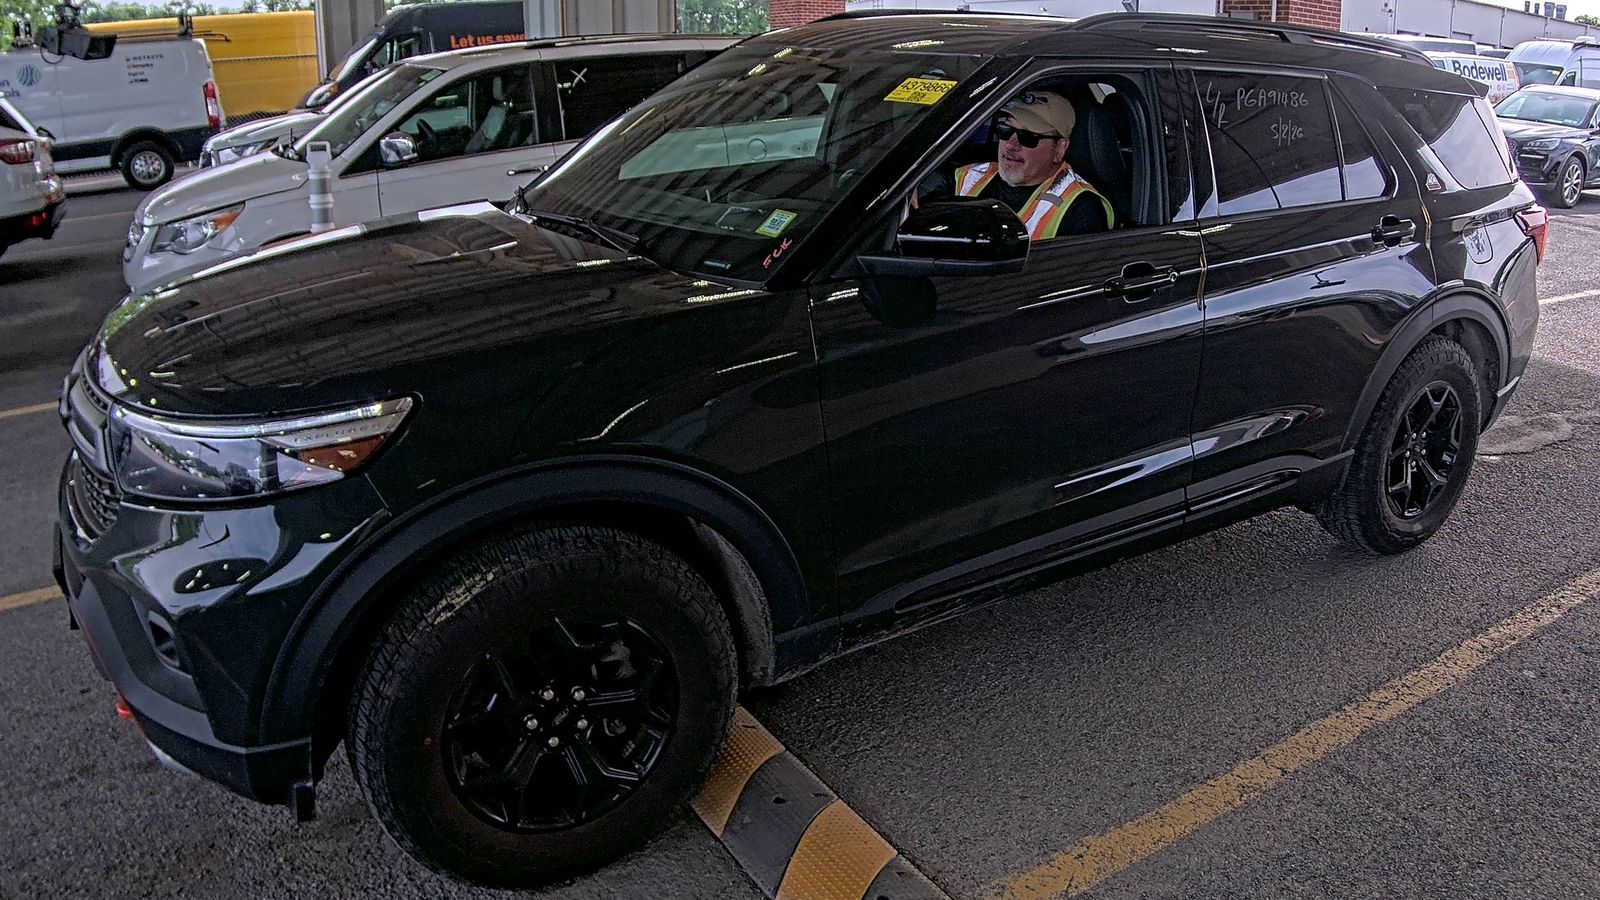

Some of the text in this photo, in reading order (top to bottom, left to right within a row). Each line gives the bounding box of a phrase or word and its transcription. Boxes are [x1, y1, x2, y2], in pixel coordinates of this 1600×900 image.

[450, 34, 475, 49] Let
[478, 34, 494, 45] us
[1452, 59, 1508, 82] Bodewell
